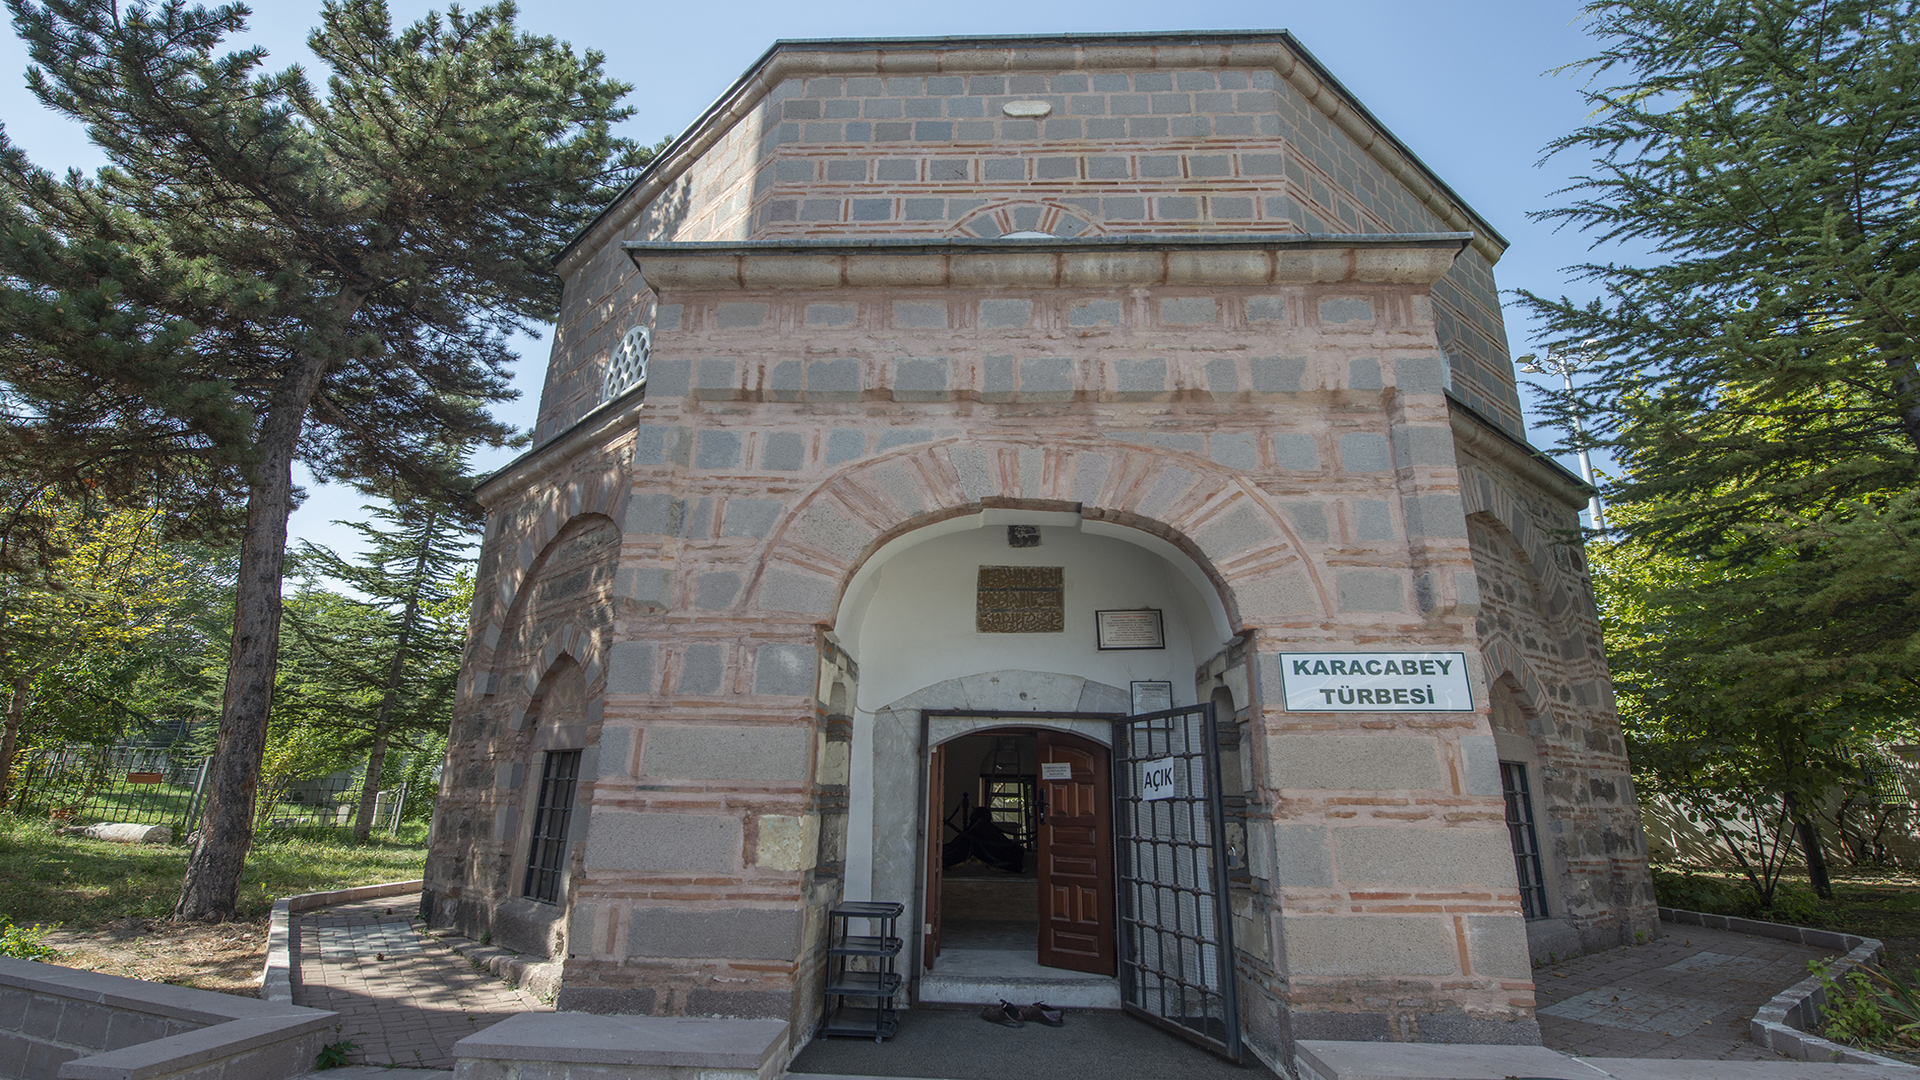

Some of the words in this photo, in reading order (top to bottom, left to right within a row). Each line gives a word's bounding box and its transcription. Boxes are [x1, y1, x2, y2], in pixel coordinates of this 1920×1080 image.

[1292, 660, 1453, 676] KARACABEY
[1319, 684, 1435, 705] TÜRBESİ
[1144, 767, 1172, 792] AÇIK
